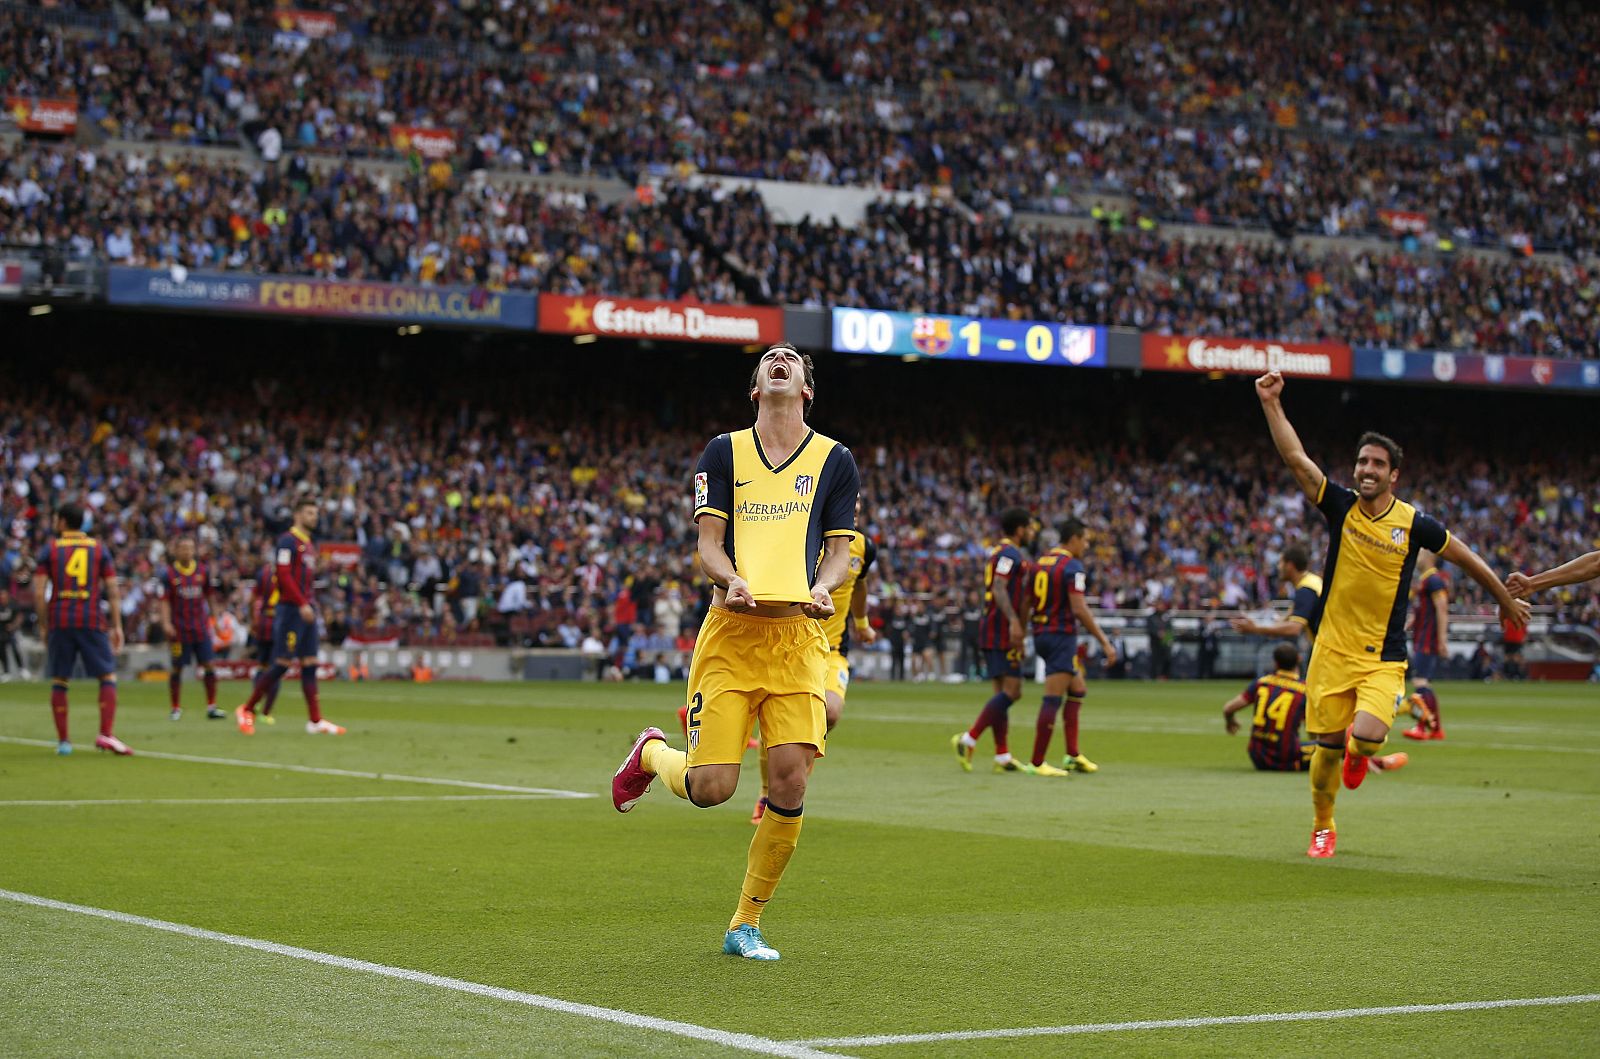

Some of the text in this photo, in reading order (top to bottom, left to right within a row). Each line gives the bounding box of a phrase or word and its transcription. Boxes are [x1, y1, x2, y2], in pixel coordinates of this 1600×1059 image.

[593, 300, 760, 341] Estrella Damm
[841, 311, 893, 352] 00
[959, 321, 981, 357] 1
[1025, 325, 1053, 361] 0
[1188, 338, 1331, 375] Estrella Damm
[740, 499, 810, 517] AZERBAIJAN
[772, 513, 788, 521] FIRE
[65, 547, 89, 587] 4
[1034, 570, 1049, 612] 9
[690, 692, 703, 728] 2
[1253, 686, 1294, 731] 14
